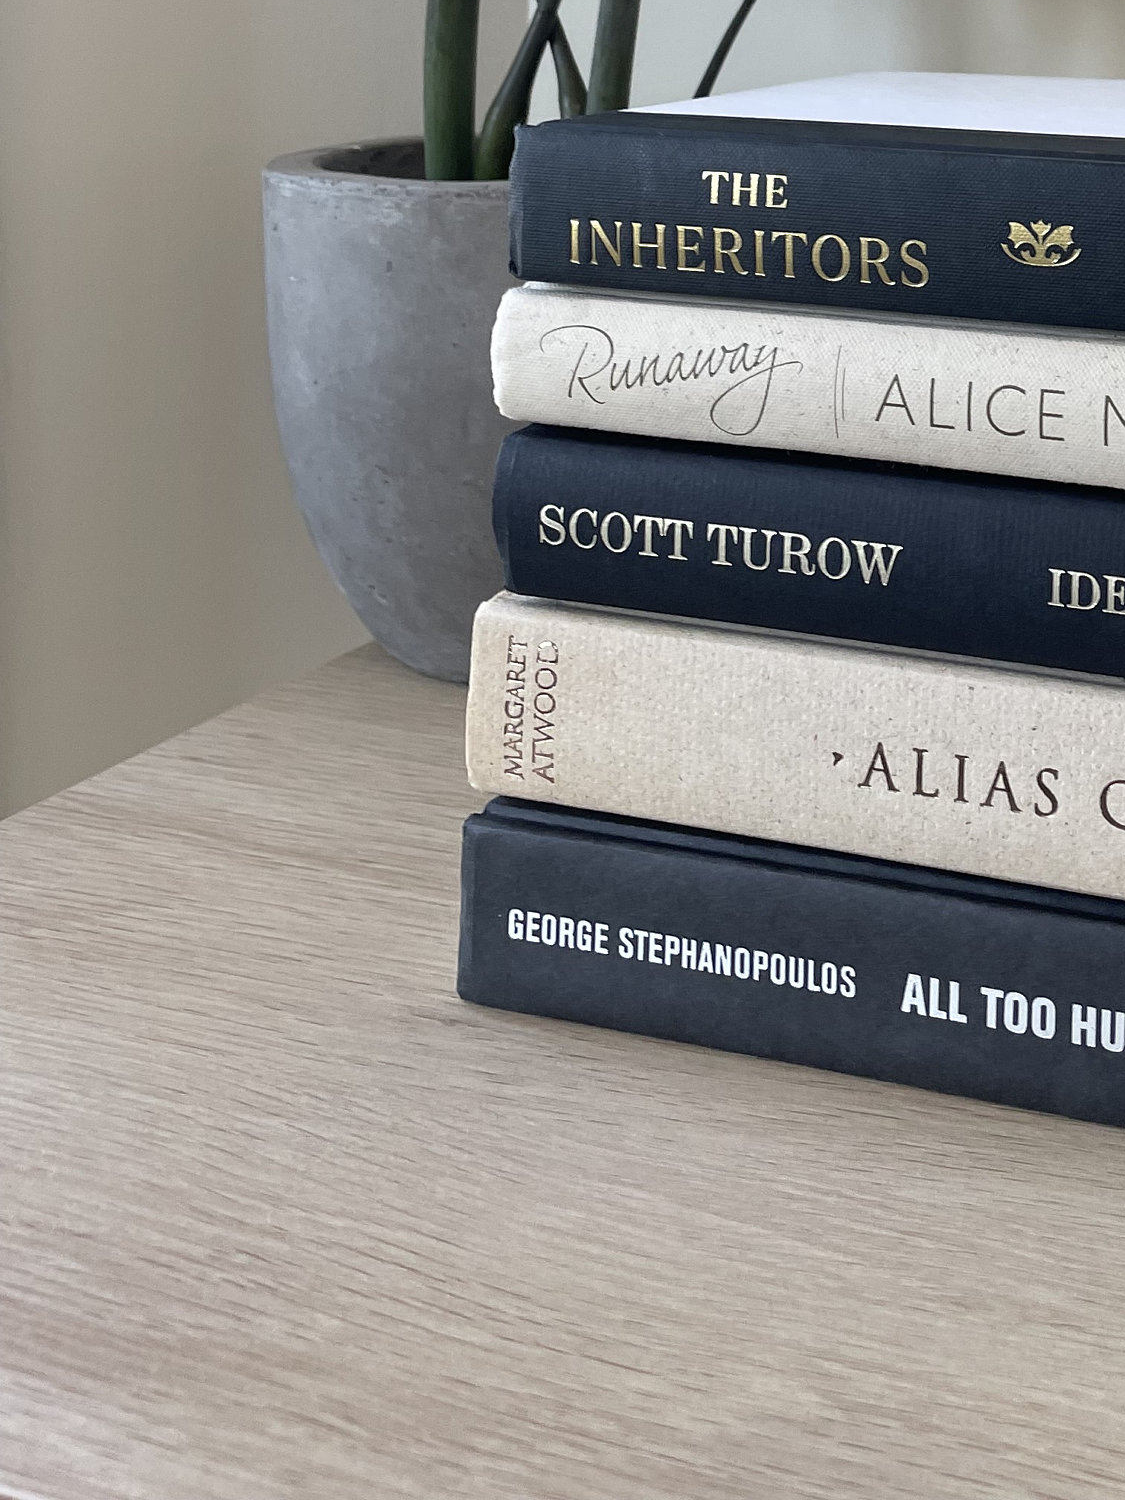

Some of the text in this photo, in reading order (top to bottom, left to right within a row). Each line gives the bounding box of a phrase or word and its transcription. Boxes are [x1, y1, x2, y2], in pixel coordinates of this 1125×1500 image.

[701, 170, 788, 209] THE
[569, 219, 930, 288] INHERITORS
[539, 324, 804, 436] Runaway
[875, 374, 1066, 442] ALICE
[538, 504, 904, 586] SCOTT TUROW
[503, 635, 528, 780] MARGARET
[532, 639, 559, 784] ATWOOD
[857, 742, 1060, 818] ALIAS
[507, 908, 857, 998] GEORGE STEPHANOPOULOS
[900, 972, 968, 1024] ALL
[980, 986, 1057, 1040] TOO
